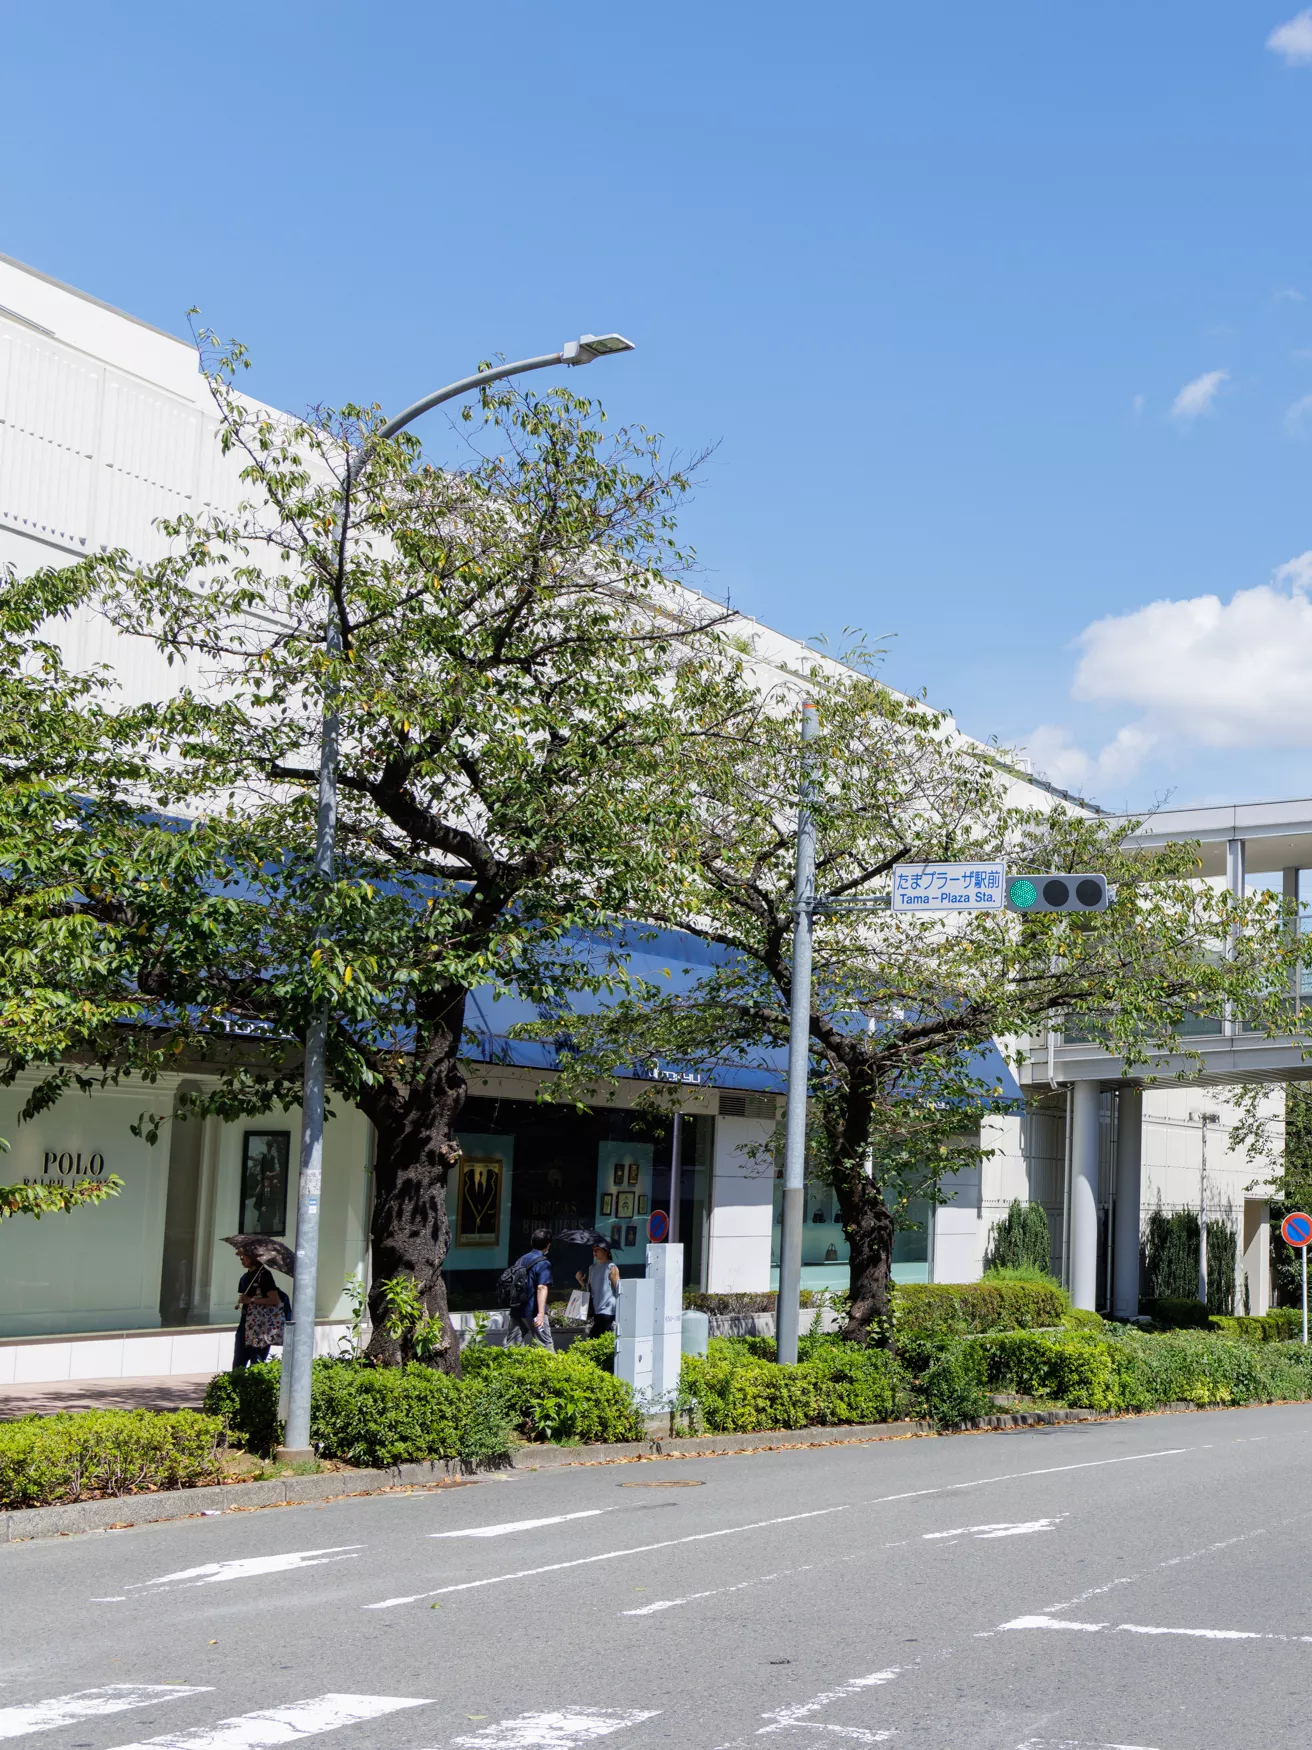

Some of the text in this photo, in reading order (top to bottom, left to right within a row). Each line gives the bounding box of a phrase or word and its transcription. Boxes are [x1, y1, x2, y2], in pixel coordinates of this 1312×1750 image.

[897, 870, 1000, 890] たまプラーザ駅前
[899, 891, 996, 905] Tama-Plaza Sta.
[42, 1152, 104, 1176] POLO
